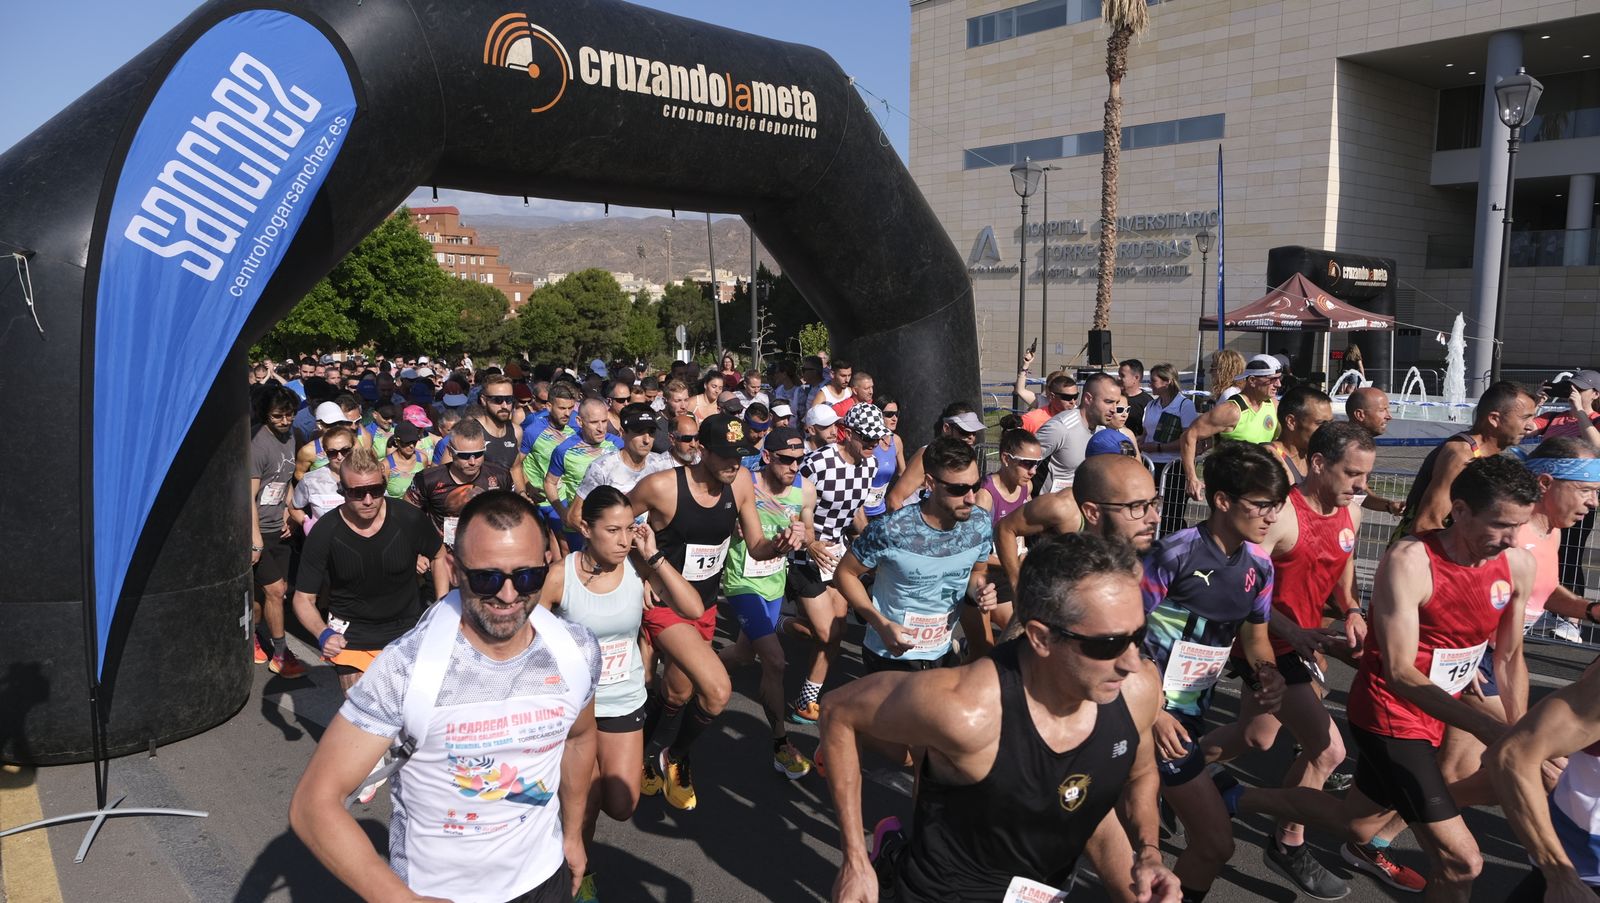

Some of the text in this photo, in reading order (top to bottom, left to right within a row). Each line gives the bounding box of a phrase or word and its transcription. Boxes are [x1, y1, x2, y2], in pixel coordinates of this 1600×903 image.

[662, 103, 817, 140] cronometraje deportivo
[229, 115, 347, 297] centrohogarsanchez.es
[458, 716, 509, 734] CARRERA
[511, 711, 532, 726] SIN
